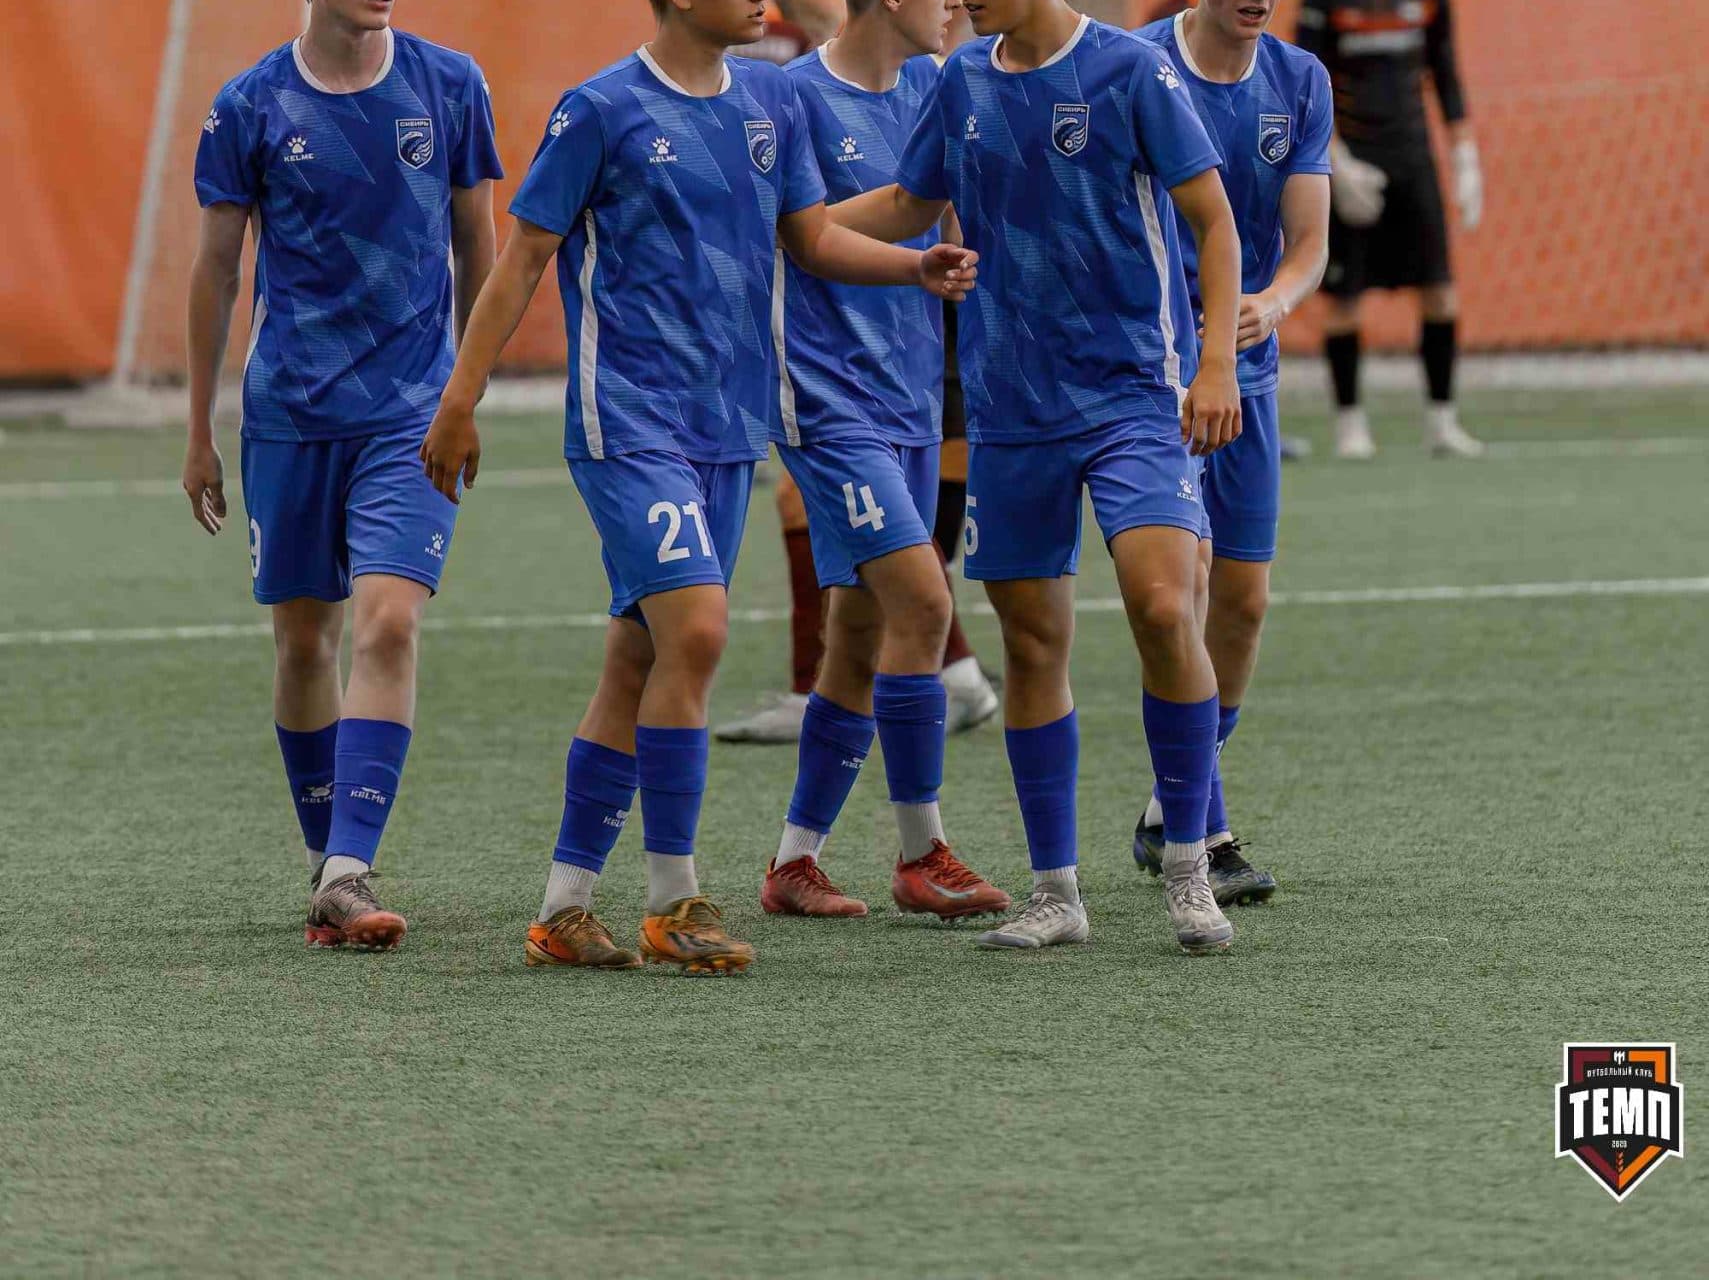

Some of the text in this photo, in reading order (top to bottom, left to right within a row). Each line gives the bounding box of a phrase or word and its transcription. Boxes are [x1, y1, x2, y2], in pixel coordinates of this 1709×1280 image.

[283, 153, 314, 162] KELME
[649, 154, 678, 163] KELME
[837, 153, 864, 162] KELME
[842, 481, 886, 532] 4
[647, 500, 713, 564] 21
[350, 790, 387, 805] KELME
